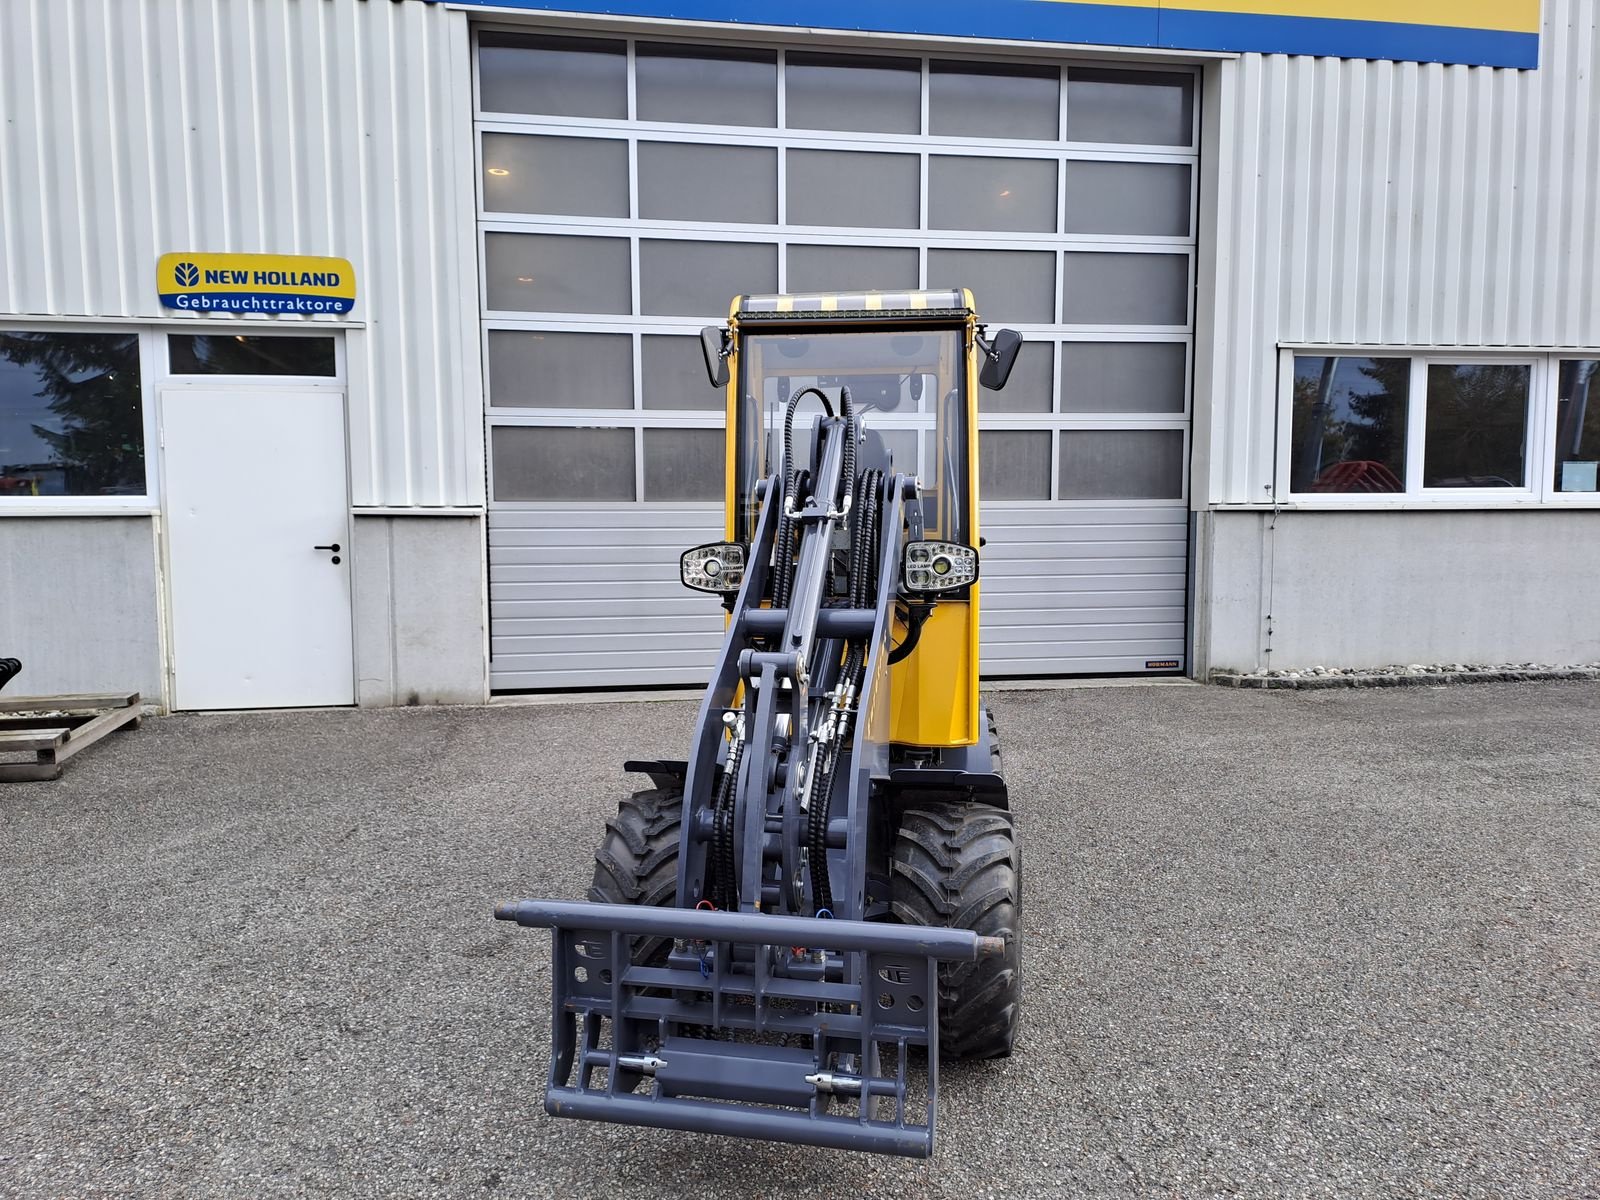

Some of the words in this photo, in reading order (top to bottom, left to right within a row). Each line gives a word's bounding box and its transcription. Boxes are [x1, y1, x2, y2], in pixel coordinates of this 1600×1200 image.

[205, 270, 249, 285] NEW
[253, 271, 340, 287] HOLLAND
[176, 294, 343, 312] Gebrauchttraktore
